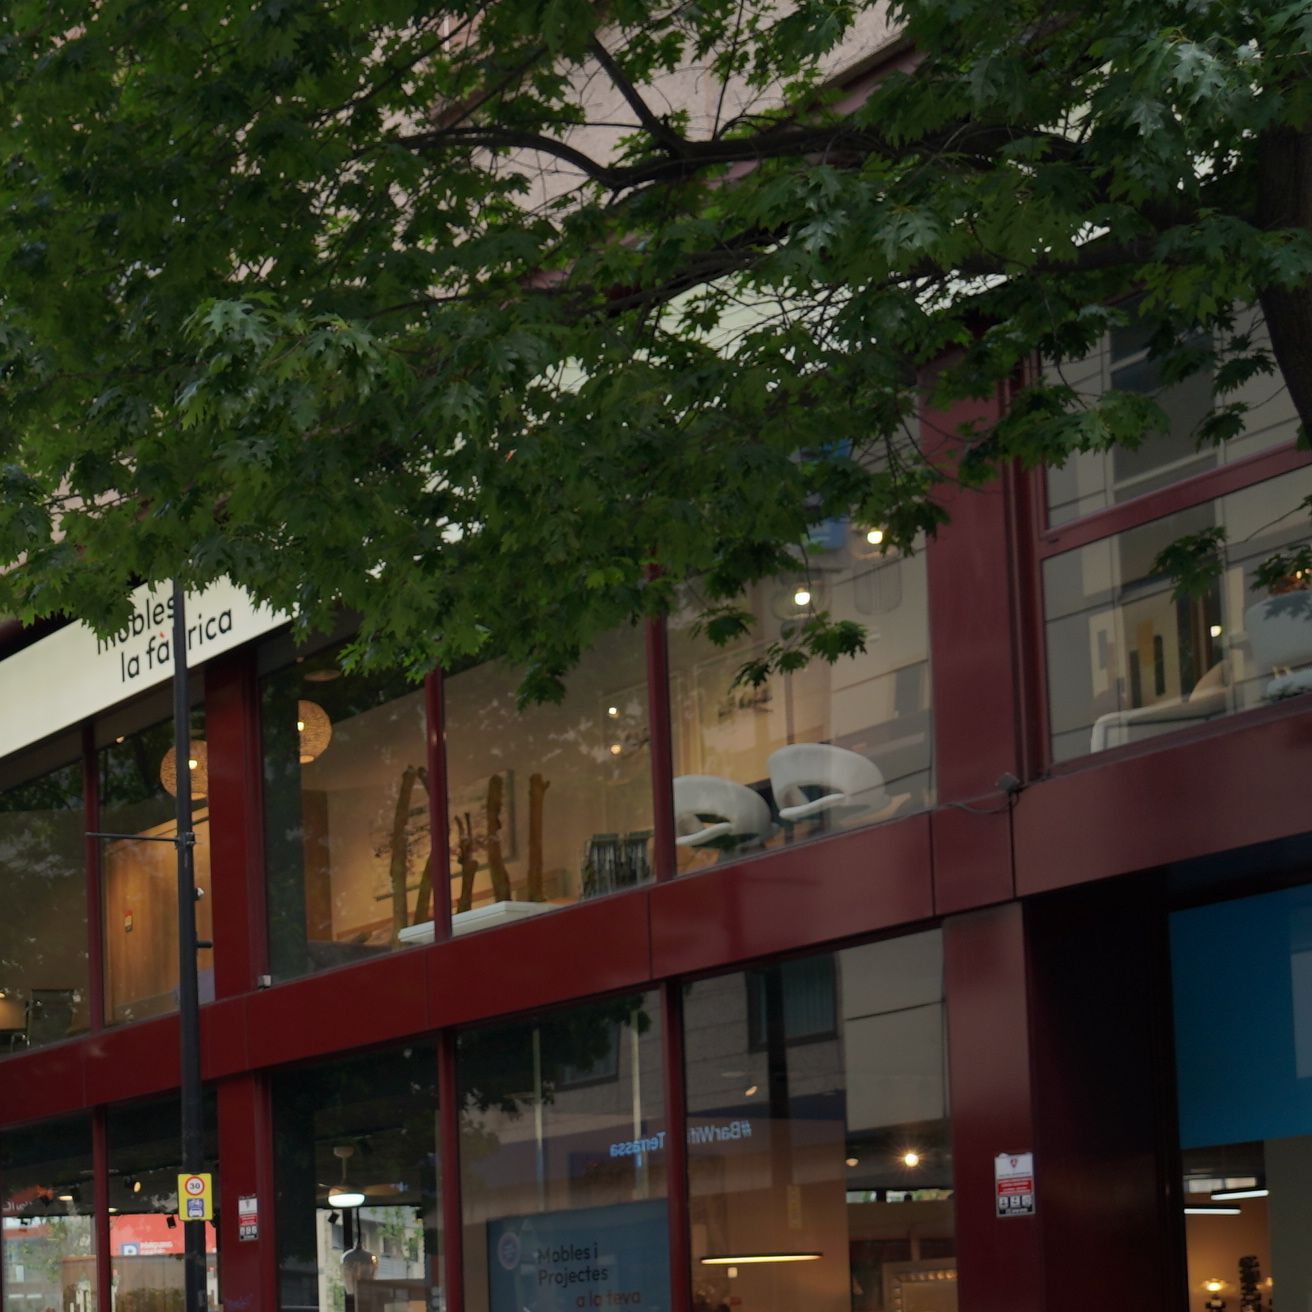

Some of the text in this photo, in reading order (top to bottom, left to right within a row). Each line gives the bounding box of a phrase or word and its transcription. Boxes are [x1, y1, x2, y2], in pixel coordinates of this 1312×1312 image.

[121, 608, 233, 683] la fàrica
[189, 1182, 201, 1190] 30
[537, 1242, 598, 1264] Mobles i
[538, 1265, 609, 1288] Projectes
